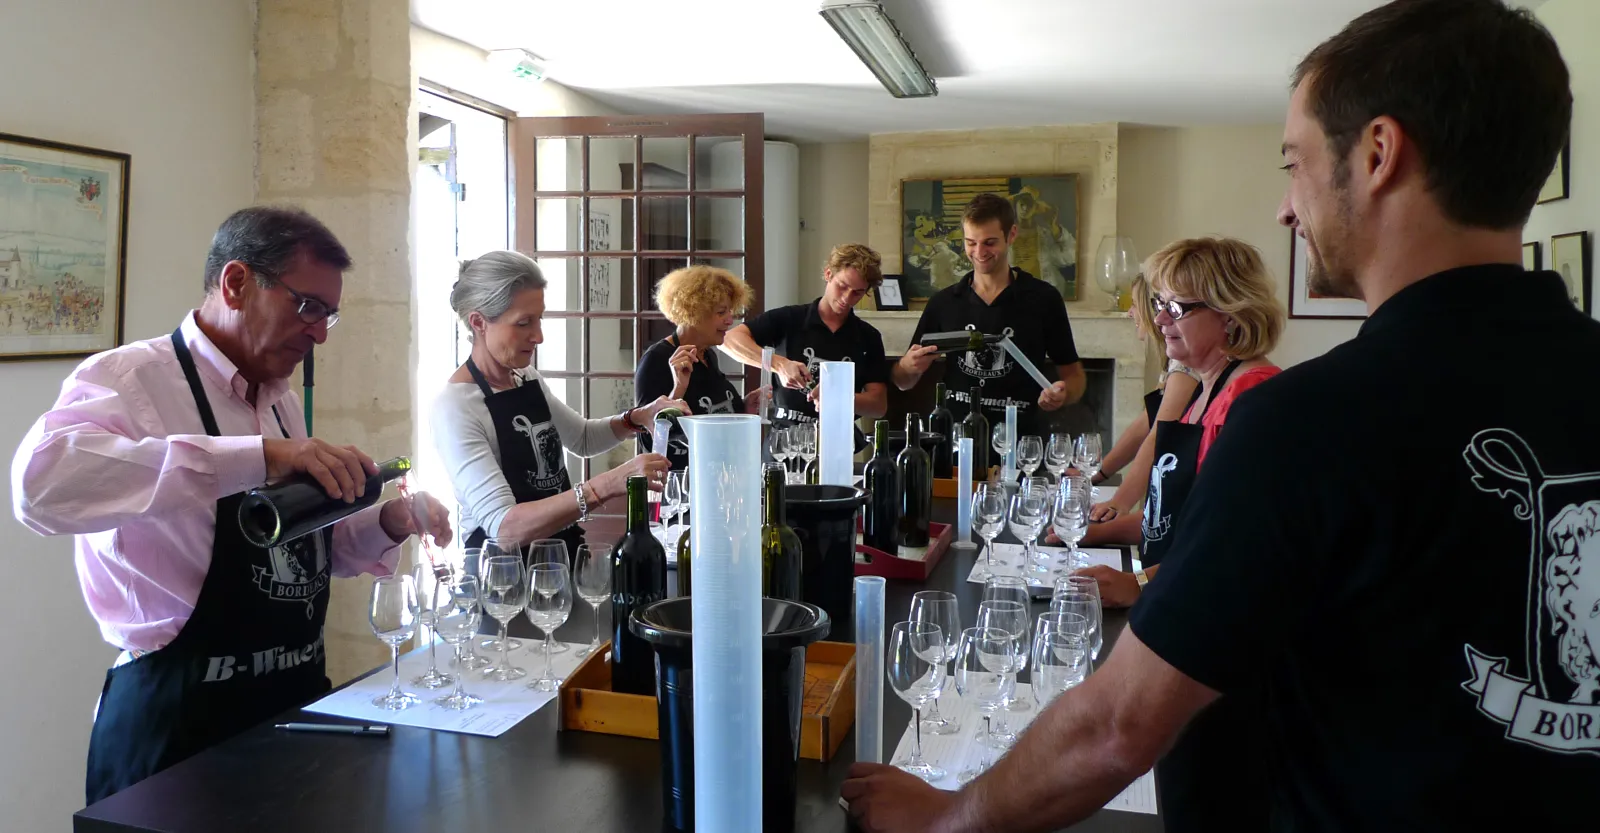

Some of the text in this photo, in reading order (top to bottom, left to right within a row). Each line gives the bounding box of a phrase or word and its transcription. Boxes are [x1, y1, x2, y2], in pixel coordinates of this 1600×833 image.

[964, 367, 1002, 377] BORDEAUX
[276, 571, 329, 597] BORDEAUX
[1531, 709, 1600, 740] BOR
